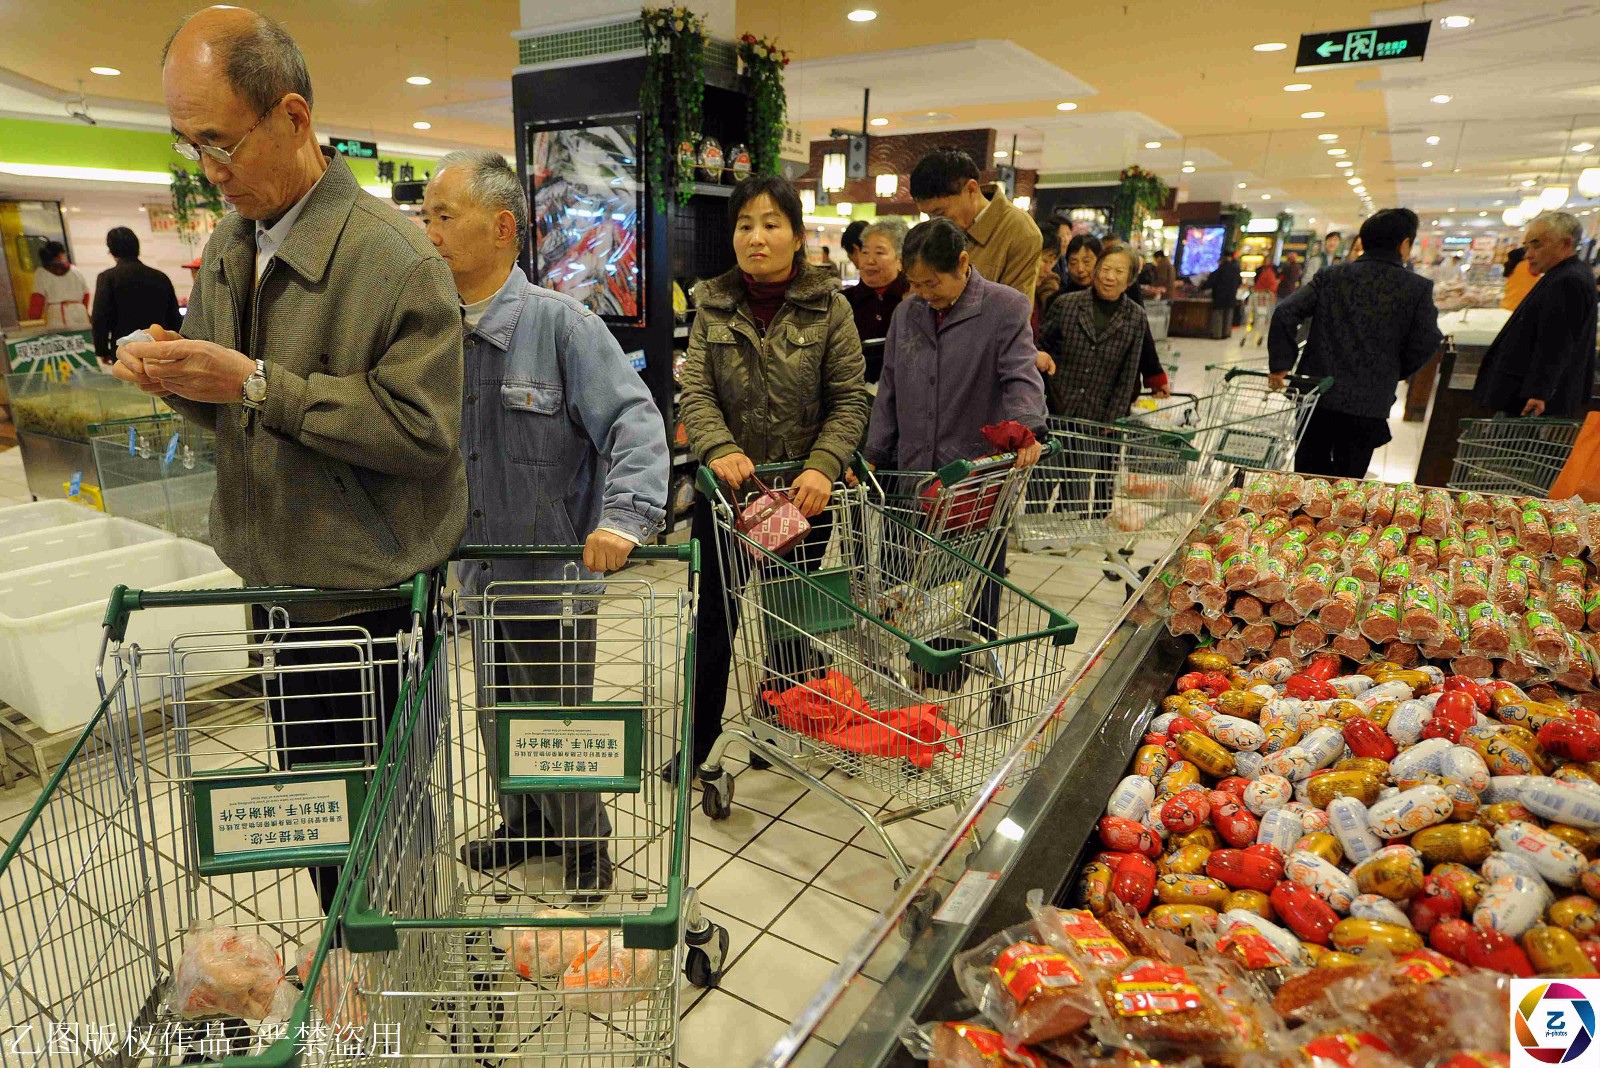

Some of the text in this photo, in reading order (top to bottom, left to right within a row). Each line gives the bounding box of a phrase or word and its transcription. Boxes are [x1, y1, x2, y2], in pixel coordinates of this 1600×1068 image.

[515, 738, 618, 749] 谨防扒手，谢谢合作
[535, 760, 598, 772] 民警提示您：
[219, 800, 341, 821] 谨防扒手，谢谢合作
[244, 828, 319, 845] 民警提示您：
